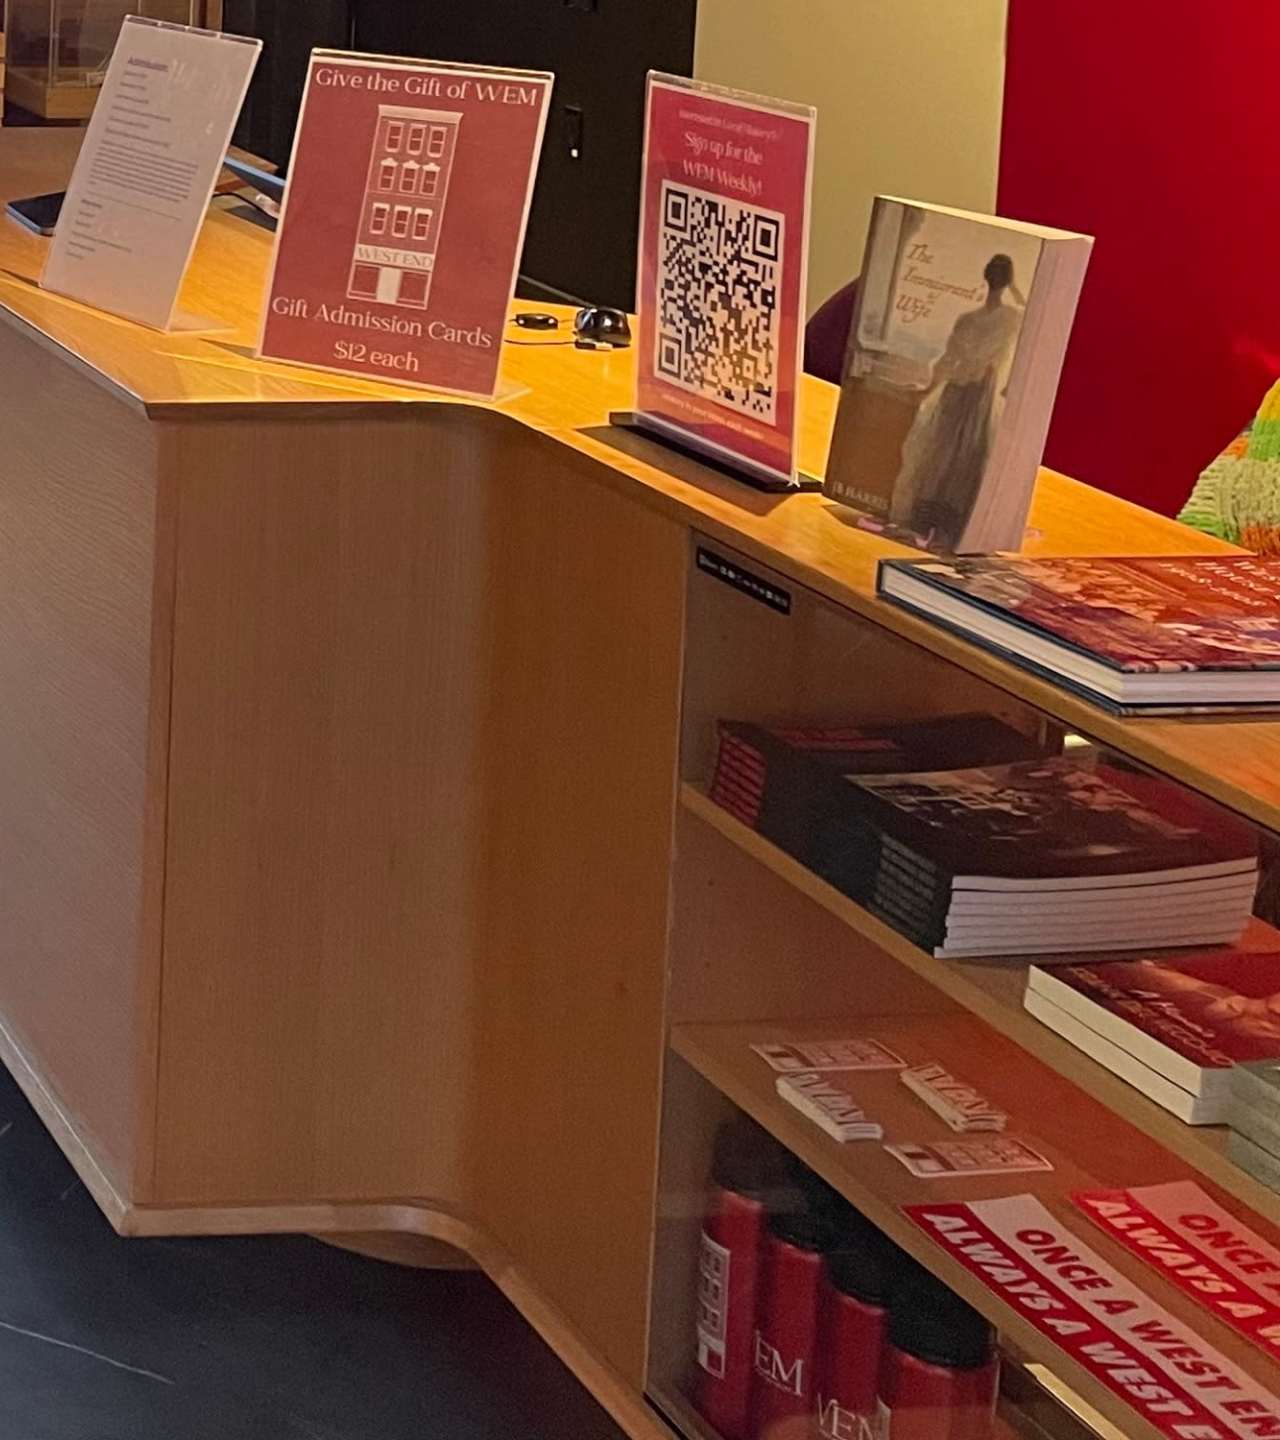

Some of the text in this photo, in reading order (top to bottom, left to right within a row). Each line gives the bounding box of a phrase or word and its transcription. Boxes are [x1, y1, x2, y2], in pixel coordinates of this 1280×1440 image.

[316, 68, 537, 106] Give the Gift of WEM
[684, 130, 763, 166] Sign up for the
[358, 247, 433, 269] WEST END
[272, 296, 492, 348] Gift Admission Cards
[333, 340, 420, 372] $12 each
[1083, 1199, 1267, 1319] ALWAYS A
[1178, 1214, 1280, 1274] ONCE
[922, 1213, 1066, 1311] ALWAYS
[1042, 1318, 1091, 1336] A
[1079, 1342, 1195, 1417] WEST
[1015, 1229, 1113, 1291] ONCE
[1093, 1299, 1139, 1315] A
[1129, 1321, 1242, 1390] WEST
[755, 1331, 804, 1396] EM
